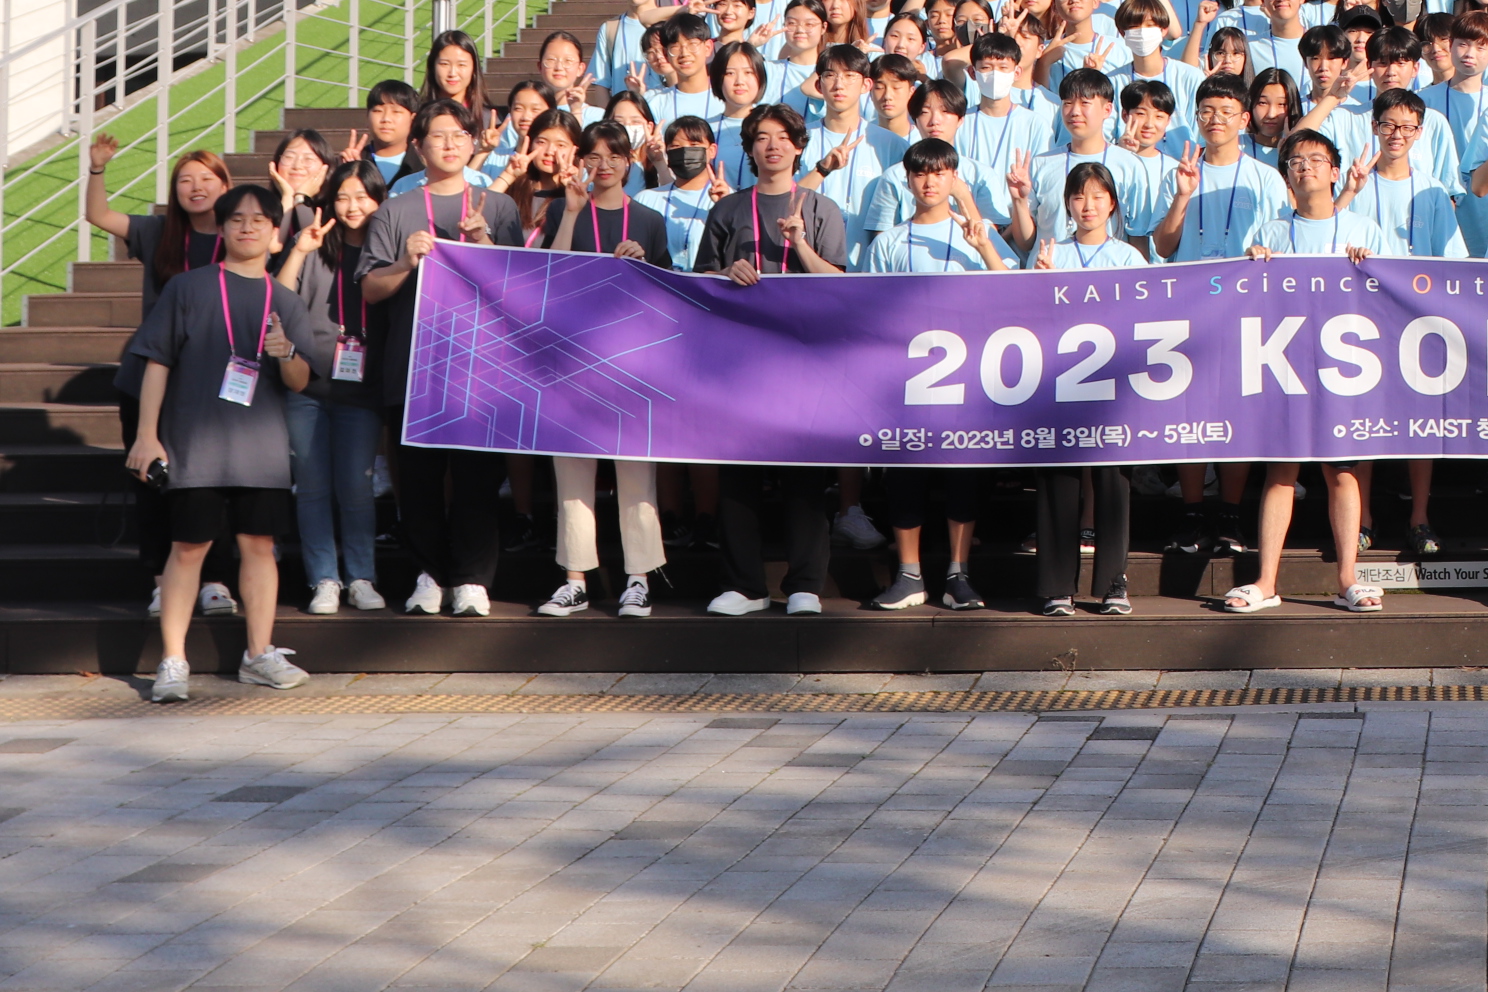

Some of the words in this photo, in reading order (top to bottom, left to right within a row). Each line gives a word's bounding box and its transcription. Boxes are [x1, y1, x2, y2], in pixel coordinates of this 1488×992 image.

[1053, 278, 1177, 305] KAIST
[1209, 273, 1380, 295] Science
[904, 320, 1194, 406] 2023
[877, 427, 933, 451] 일정:
[941, 429, 1014, 449] 2023년
[1020, 427, 1056, 449] 8월
[1062, 424, 1132, 449] 3일(목)
[1163, 420, 1233, 446] 5일(토)
[1350, 418, 1399, 441] 장소:
[1408, 419, 1473, 438] KAIST
[1415, 567, 1451, 580] Watch
[1453, 567, 1480, 580] Your
